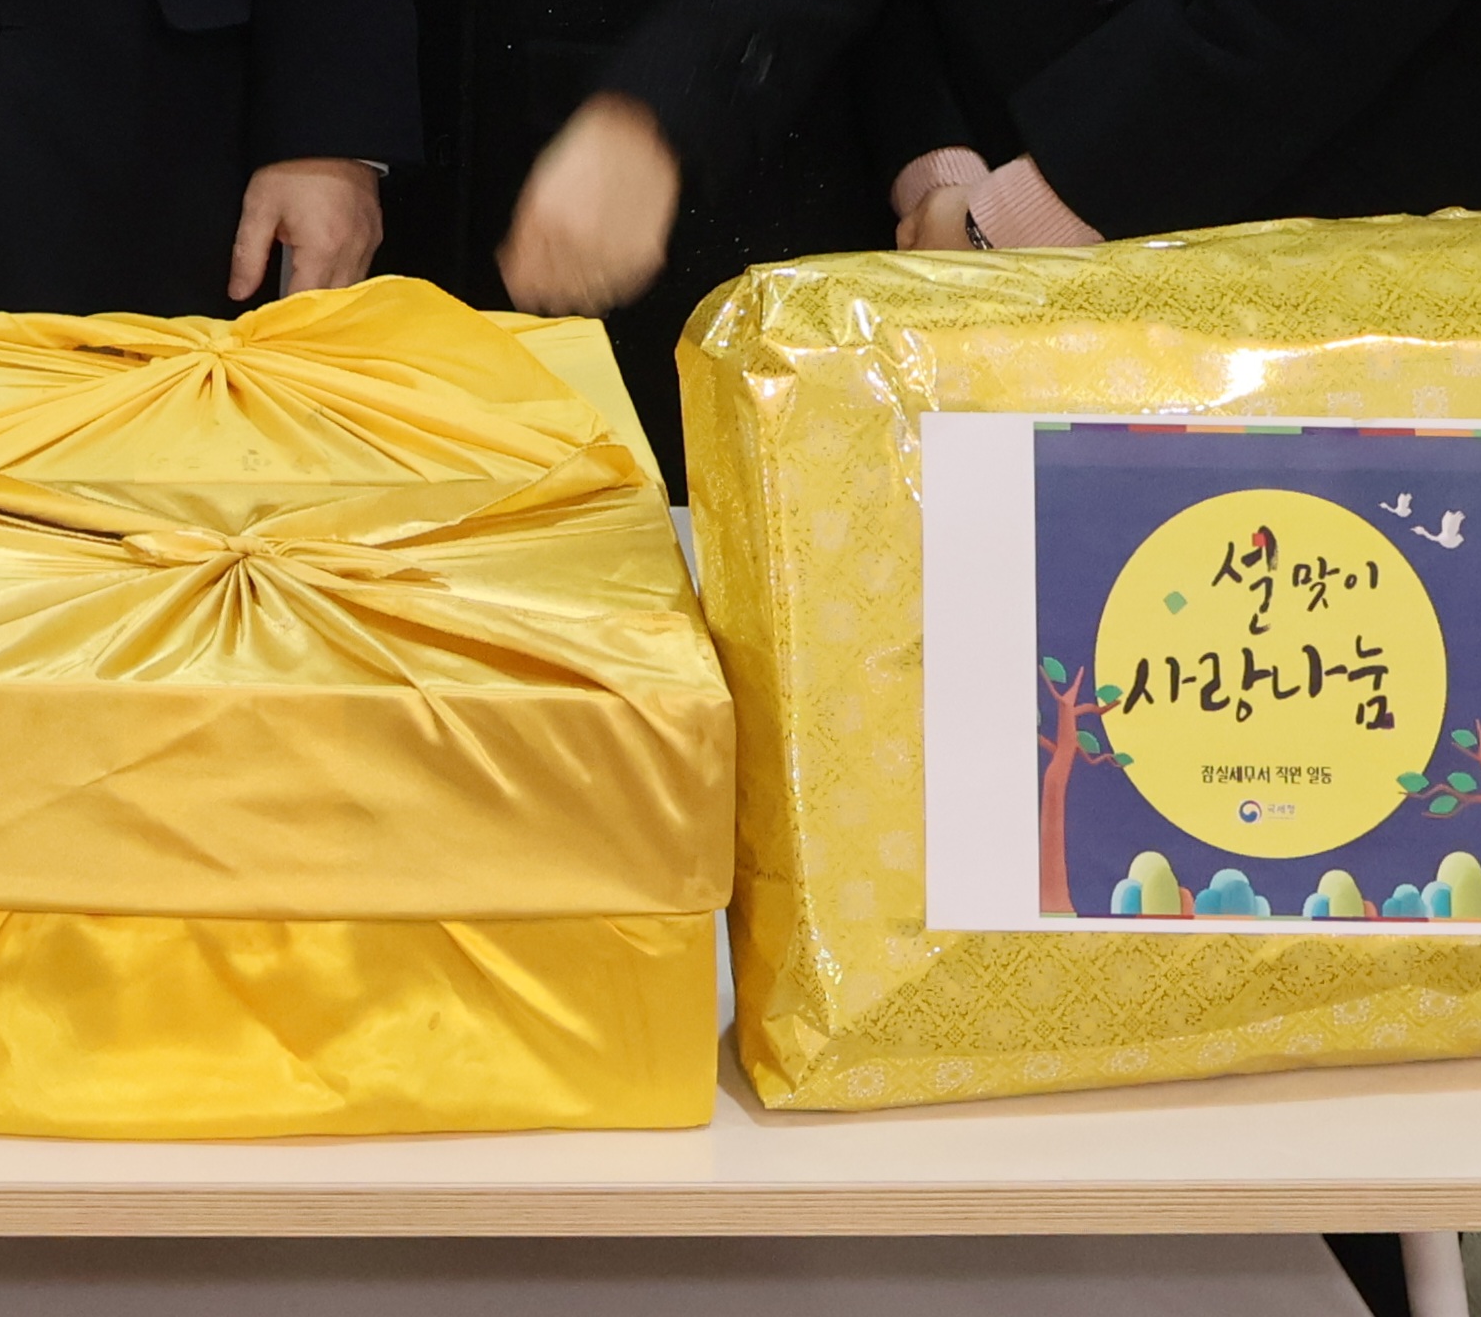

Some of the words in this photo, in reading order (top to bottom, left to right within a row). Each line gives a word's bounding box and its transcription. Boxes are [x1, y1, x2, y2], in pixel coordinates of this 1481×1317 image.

[1212, 525, 1278, 635] 설
[1292, 556, 1378, 612] 맞이
[1123, 635, 1394, 730] 사랑나눔
[1202, 766, 1270, 783] 잠실세무서
[1276, 766, 1301, 784] 직원
[1307, 767, 1331, 784] 일동
